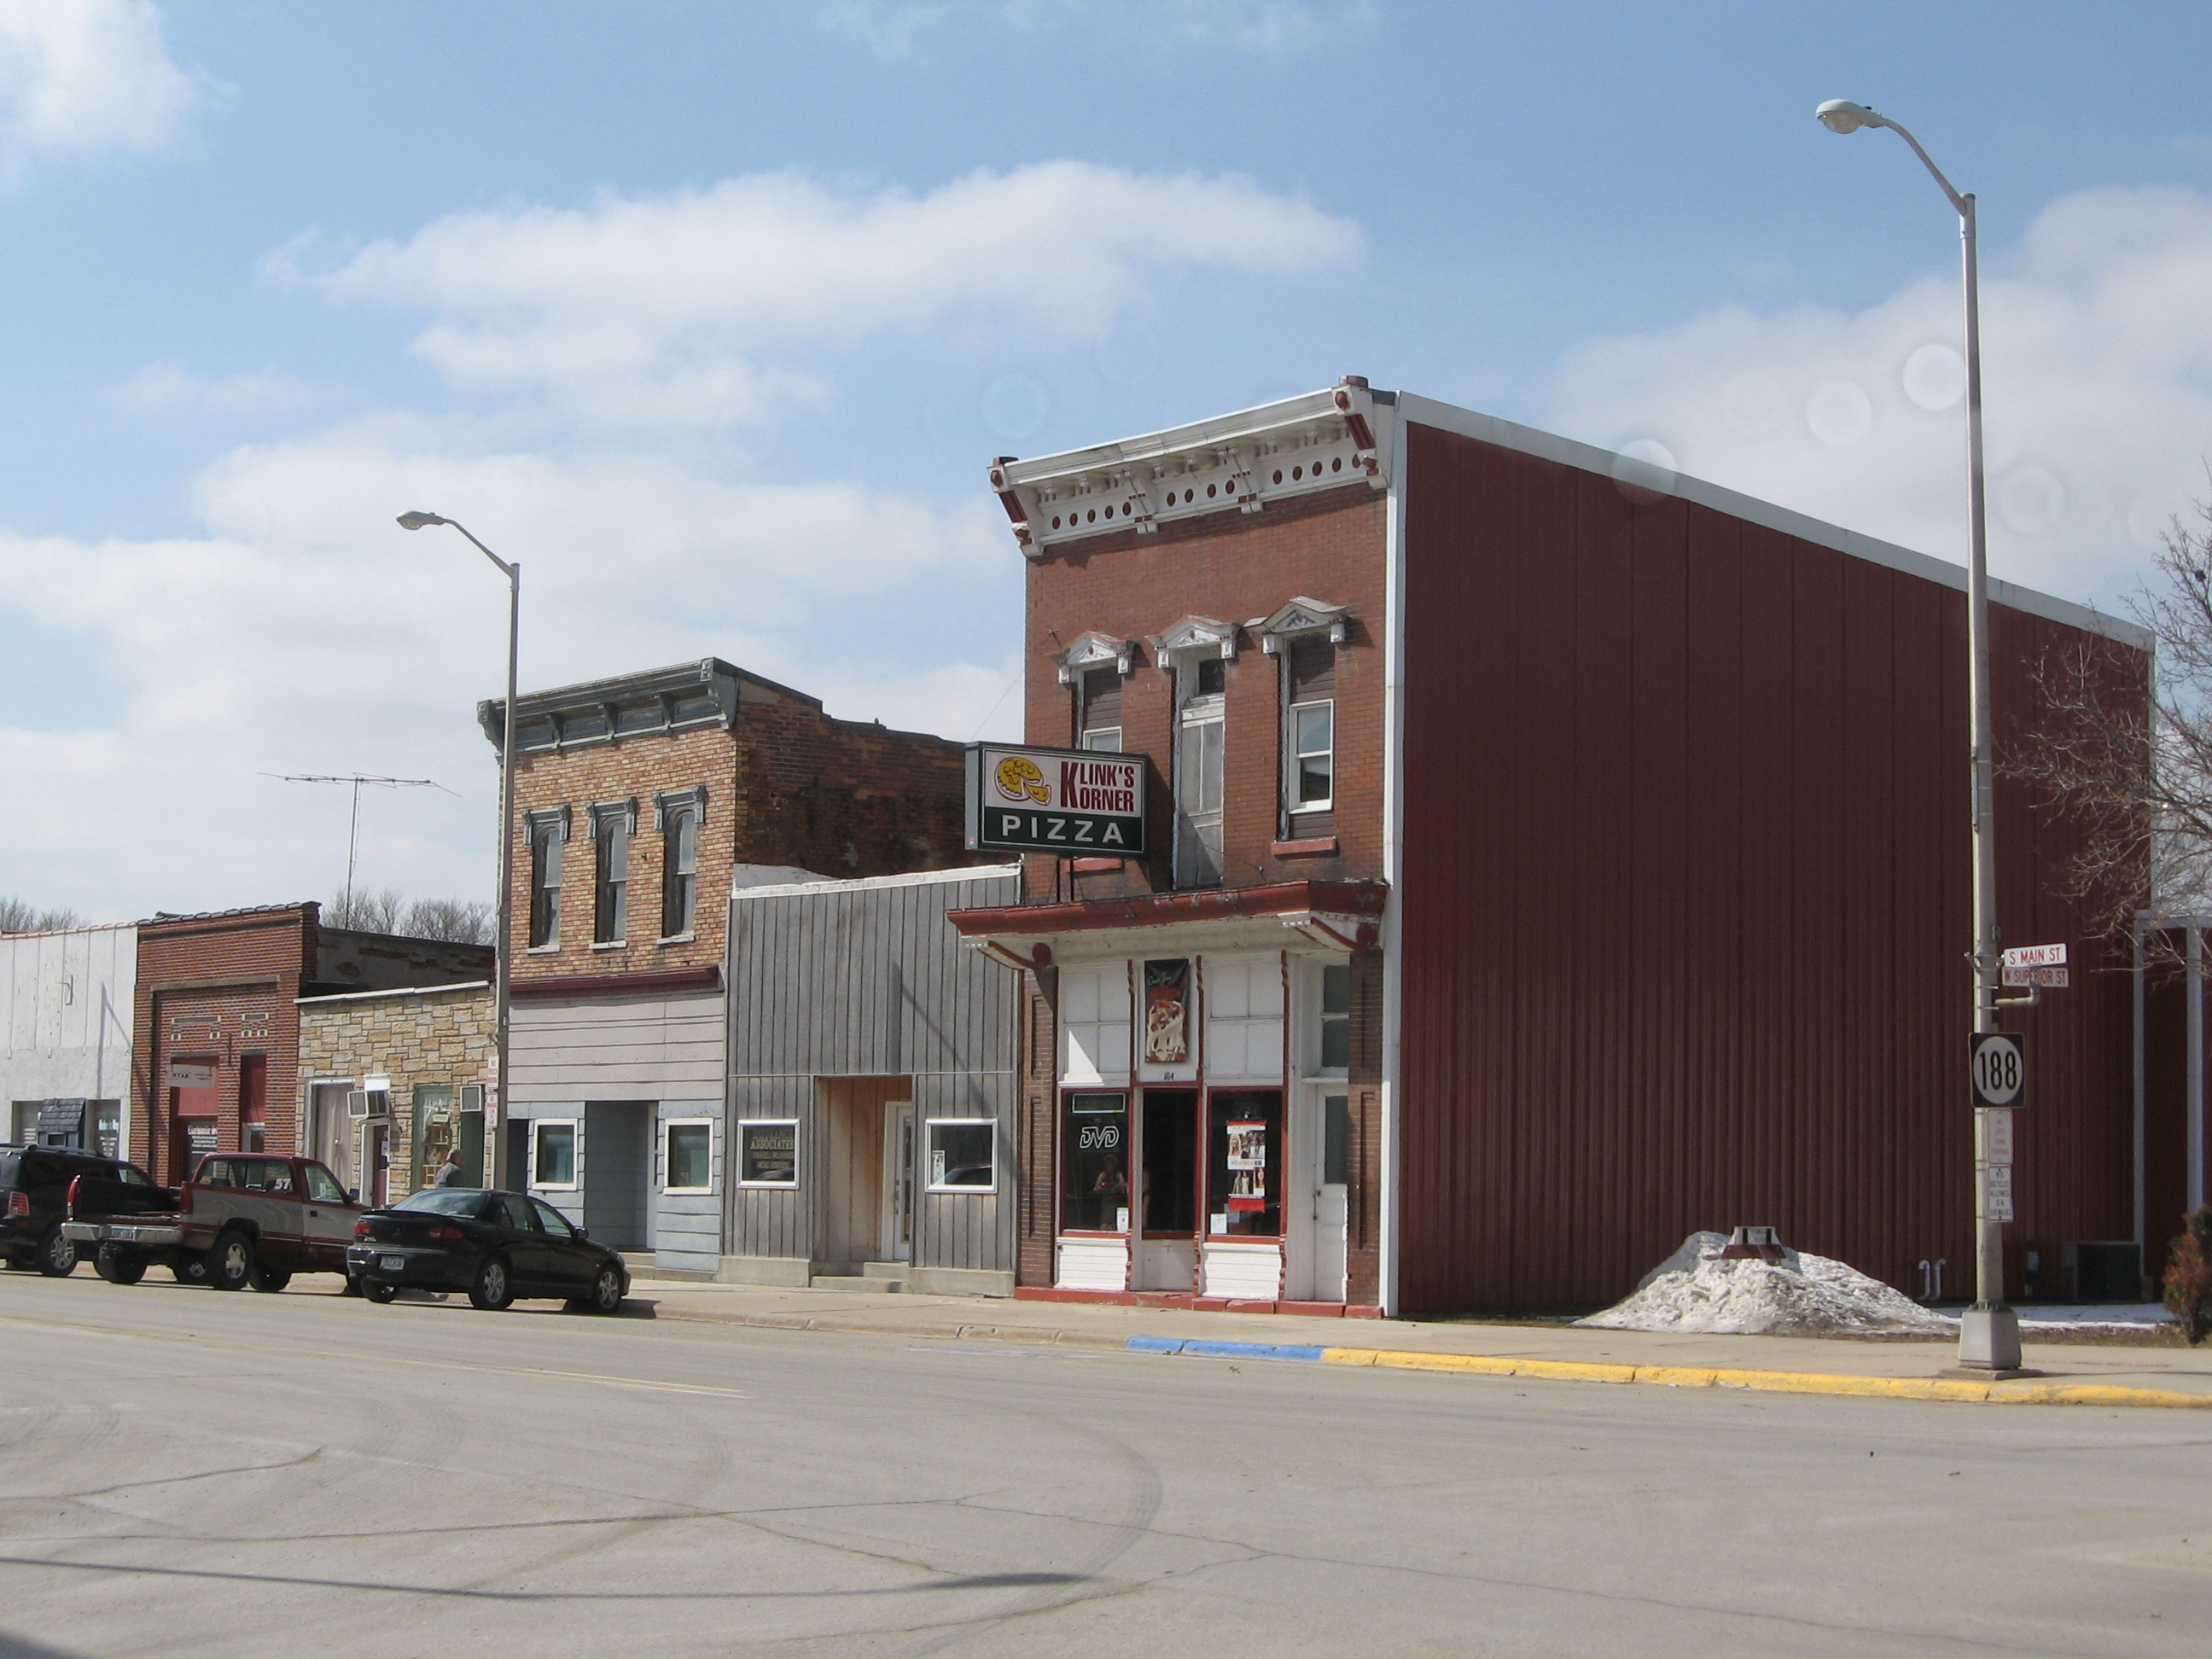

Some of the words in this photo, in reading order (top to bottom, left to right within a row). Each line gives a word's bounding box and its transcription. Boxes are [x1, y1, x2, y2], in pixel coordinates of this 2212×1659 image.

[1002, 814, 1125, 844] PIZZA
[2009, 951, 2016, 965] S
[2020, 949, 2045, 963] MAIN
[2049, 947, 2061, 962] ST
[2005, 970, 2011, 982] W
[2057, 970, 2066, 984] ST
[1979, 1051, 2017, 1091] 188
[750, 1139, 794, 1150] ASSOCIATES
[1080, 1126, 1119, 1149] DVD
[274, 1178, 291, 1190] 57
